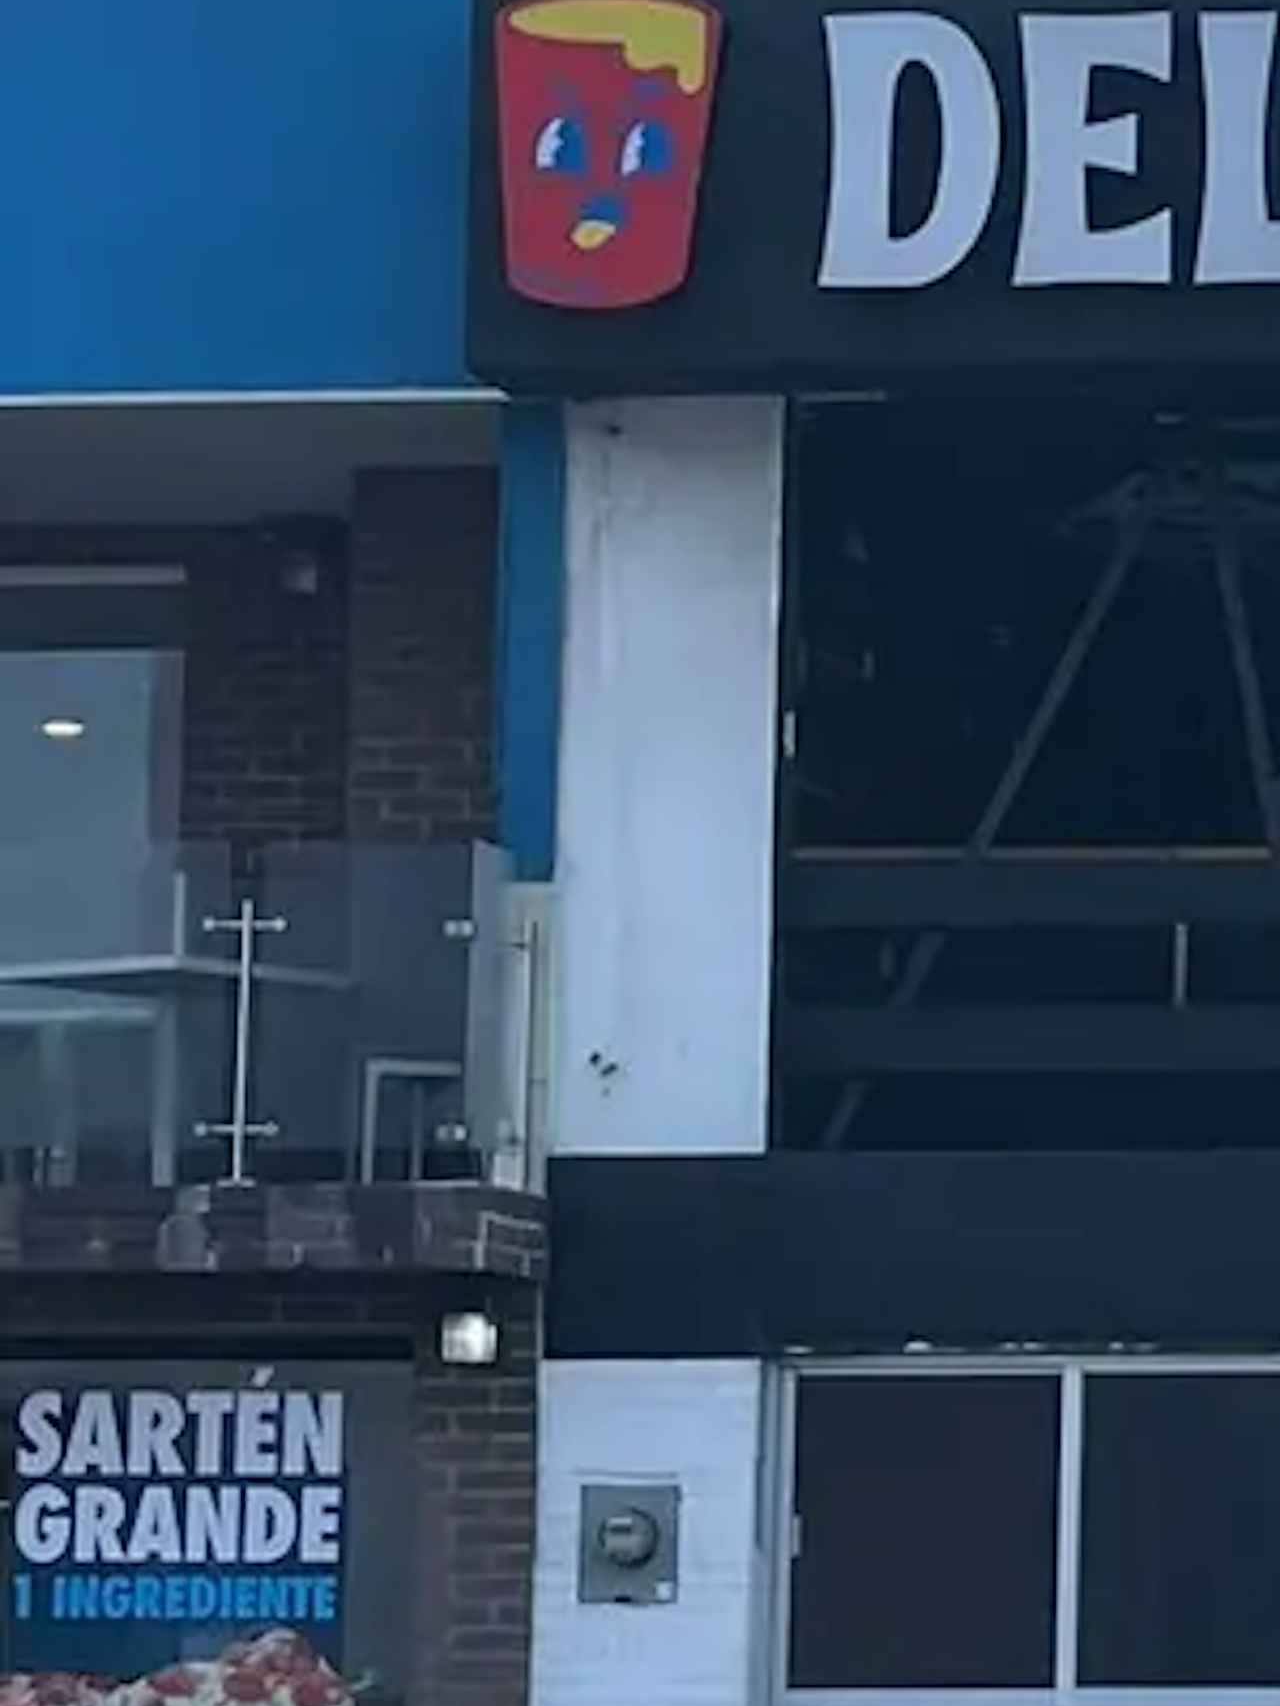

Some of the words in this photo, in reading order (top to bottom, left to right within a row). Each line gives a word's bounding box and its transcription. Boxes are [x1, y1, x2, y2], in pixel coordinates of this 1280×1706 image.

[15, 1365, 345, 1476] SARTÉN
[14, 1483, 344, 1565] GRANDE
[14, 1574, 32, 1620] 1
[53, 1575, 337, 1620] INGREDIENTE
